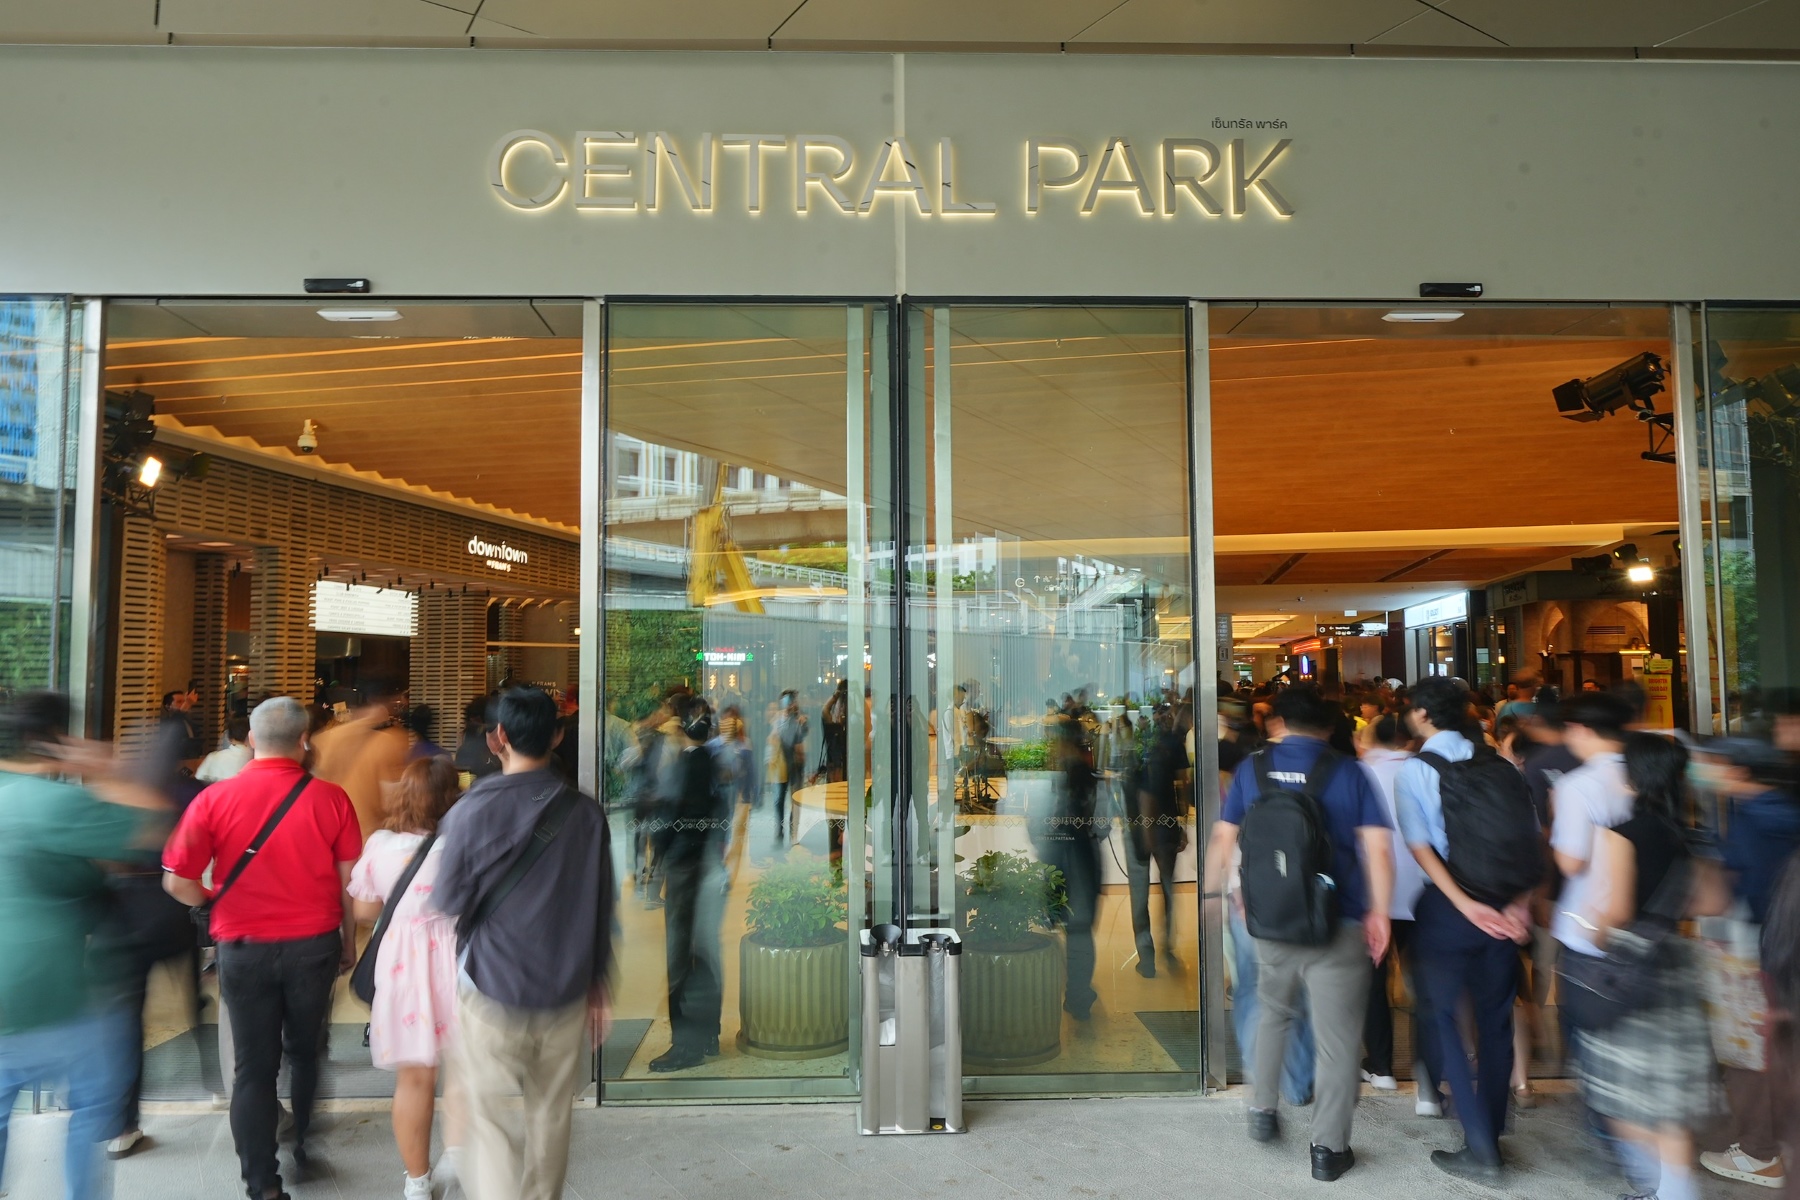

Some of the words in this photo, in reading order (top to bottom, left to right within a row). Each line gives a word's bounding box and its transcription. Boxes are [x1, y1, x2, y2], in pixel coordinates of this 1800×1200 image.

[1211, 116, 1253, 129] เซ็นทรัล
[1255, 118, 1288, 129] พาร์ค
[489, 128, 996, 217] CENTRAL
[1025, 136, 1296, 218] PARK
[467, 535, 528, 564] downtown
[1015, 577, 1025, 588] G
